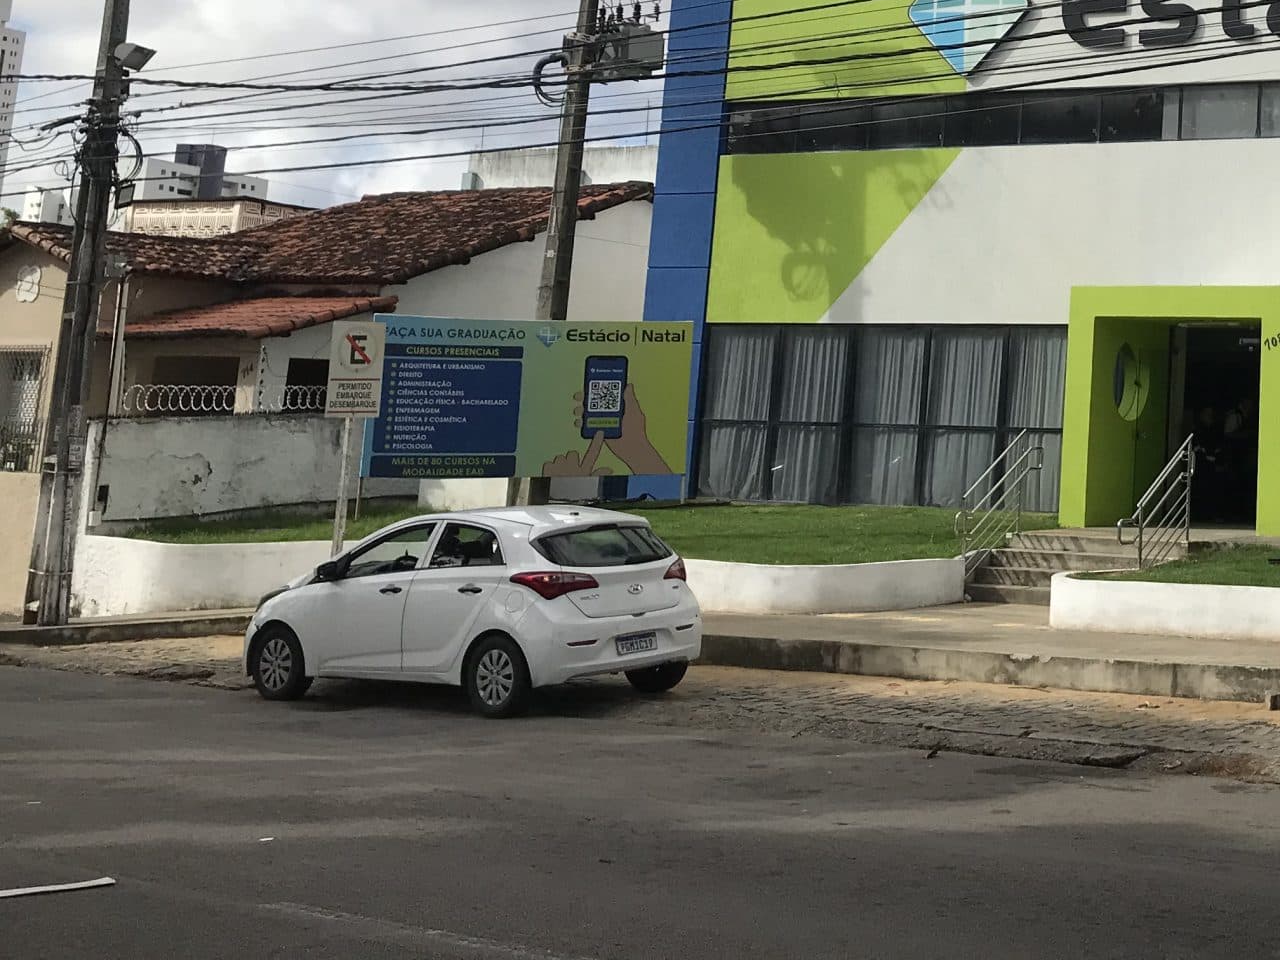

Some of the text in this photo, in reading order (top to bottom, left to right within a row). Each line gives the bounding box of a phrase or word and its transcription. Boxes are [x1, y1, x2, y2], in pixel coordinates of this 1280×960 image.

[421, 328, 443, 338] SUA
[447, 328, 526, 341] GRADUAÇÃO
[566, 329, 686, 342] Estácio Natal
[406, 346, 500, 356] CURSOS PRESENCIAIS
[337, 382, 372, 390] PERMITIDO
[398, 380, 452, 388] ADMINISTRAÇÃO
[336, 391, 372, 400] EMBARQUE
[430, 389, 465, 397] CONTÁBEIS
[329, 400, 377, 408] DESEMBARQUE
[396, 398, 434, 406] EDUCAÇÃO
[435, 398, 456, 406] FÍSICA
[393, 433, 427, 441] NUTRIÇÃO
[392, 457, 415, 465] MAIS
[417, 457, 429, 465] DE
[444, 457, 480, 465] CURSOS
[402, 467, 484, 476] MODALIDADE EAD
